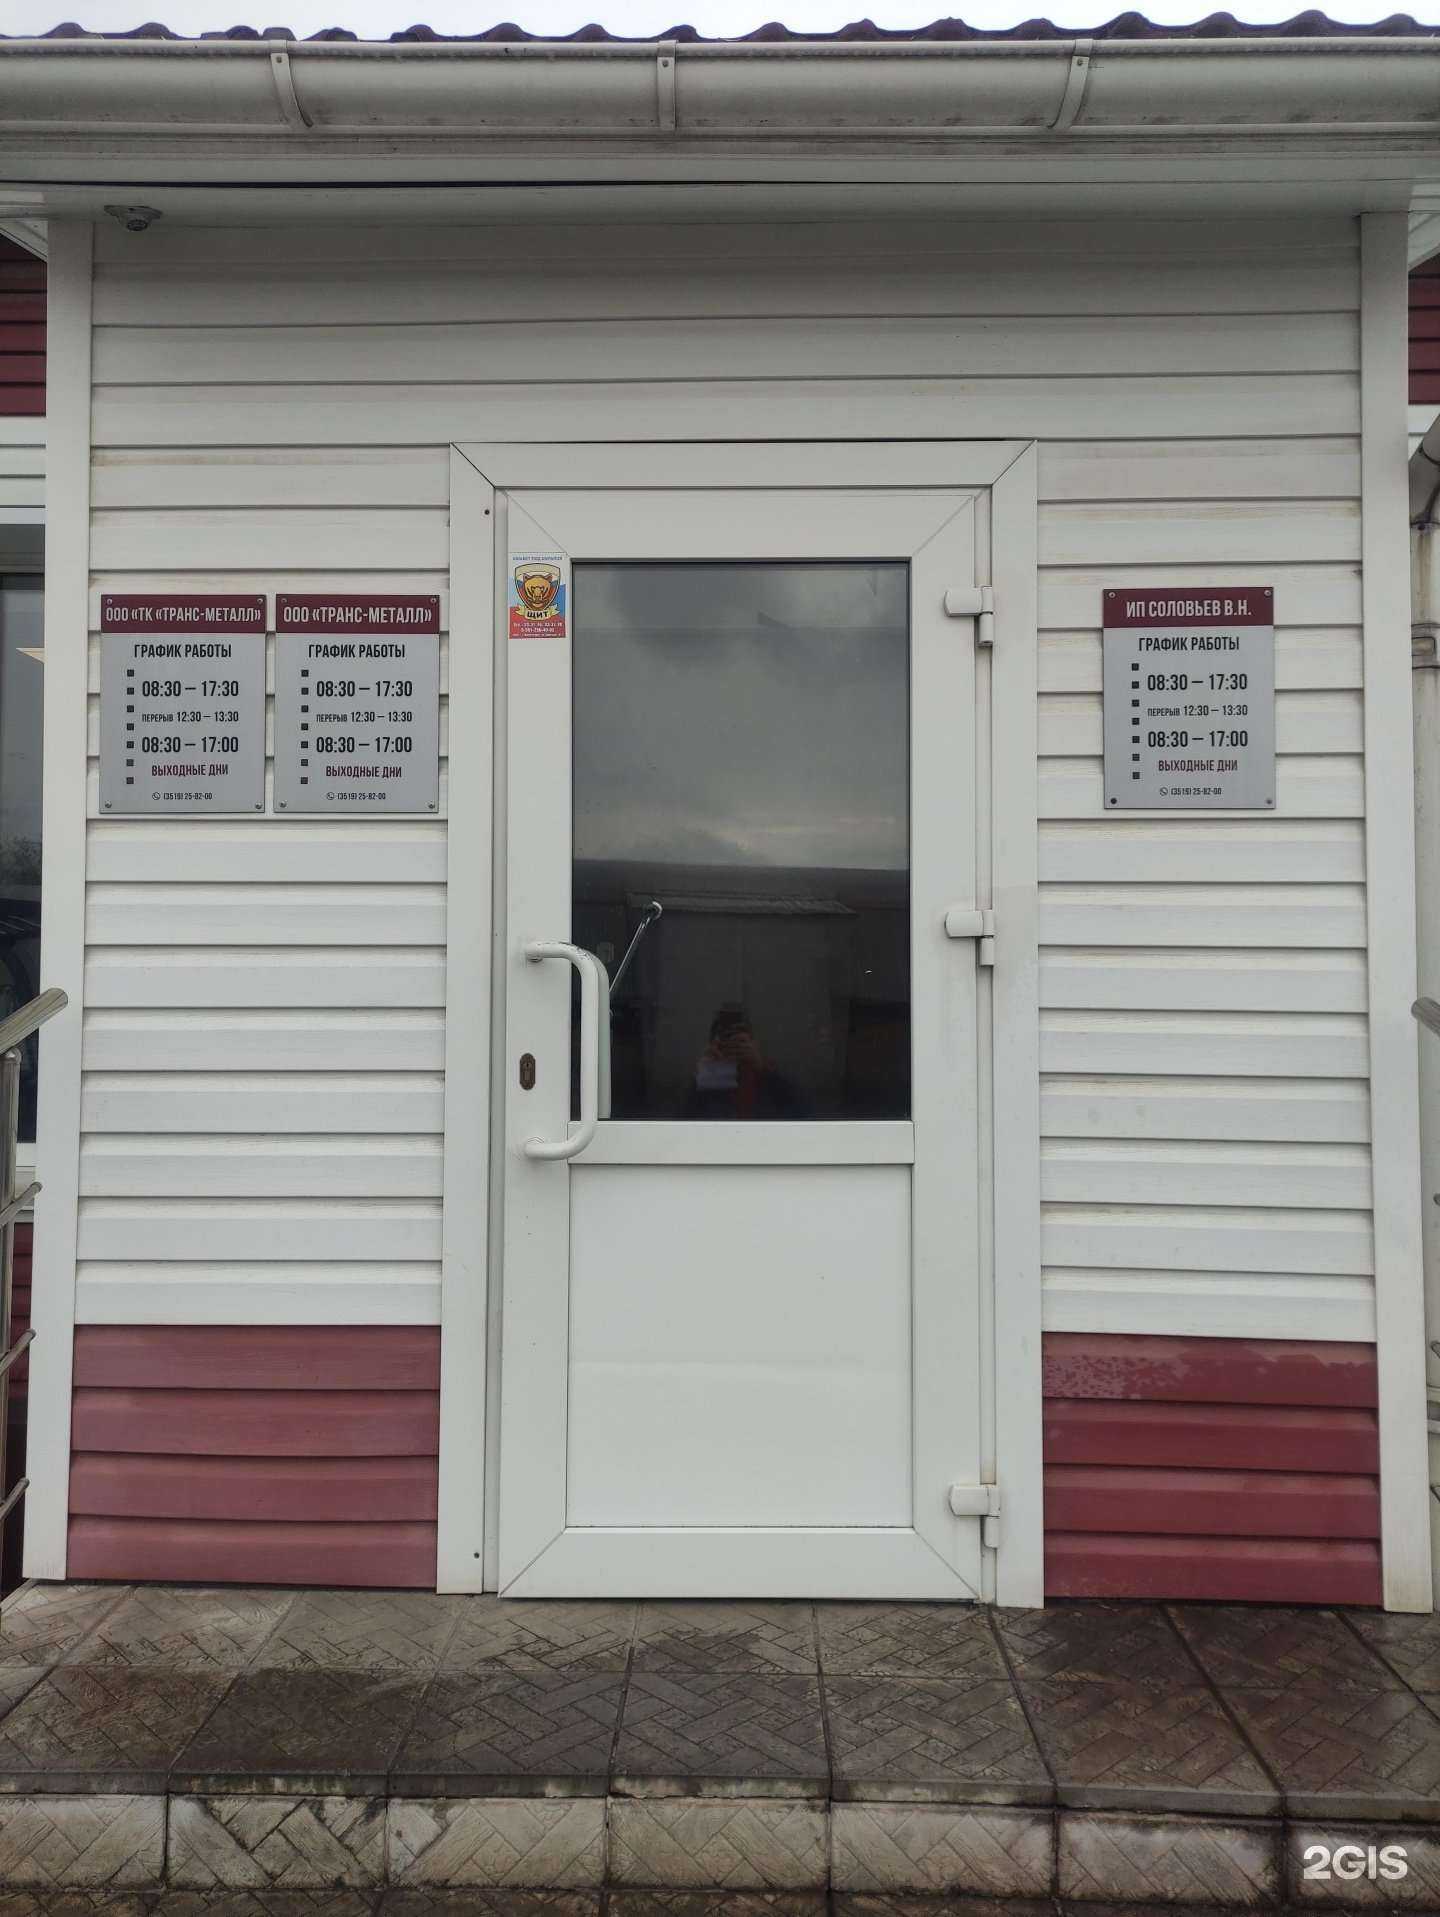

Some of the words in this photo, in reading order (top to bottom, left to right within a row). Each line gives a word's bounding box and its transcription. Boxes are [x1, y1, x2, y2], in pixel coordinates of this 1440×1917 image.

[106, 608, 128, 621] ООО
[132, 608, 152, 621] «ТК
[156, 608, 260, 622] «ТРАНС-МЕТАЛЛ»
[284, 607, 309, 622] ООО
[313, 607, 431, 623] «ТРАНС-МЕТАЛЛ»
[527, 611, 548, 619] ЩИТ
[1126, 602, 1145, 617] ИП
[1149, 600, 1220, 617] СОЛОВЬЕВ
[1225, 600, 1251, 615] В.Н.
[135, 644, 181, 657] ГРАФИК
[185, 644, 231, 657] РАБОТЫ
[1139, 638, 1187, 651] ГРАФИК
[1191, 637, 1239, 650] РАБОТЫ
[309, 645, 355, 658] ГРАФИК
[359, 645, 405, 658] РАБОТЫ
[142, 681, 181, 696] 08:30
[202, 681, 238, 696] 17:30
[317, 681, 355, 696] 08:30
[376, 681, 412, 696] 17:30
[1148, 675, 1187, 690] 08:30
[1209, 674, 1247, 690] 17:30
[142, 714, 173, 722] ПЕРЕРЫВ
[177, 712, 200, 722] 12:30
[215, 712, 238, 722] 13:30
[316, 714, 347, 722] ПЕРЕРЫВ
[351, 712, 375, 722] 12:30
[389, 712, 412, 722] 13:30
[1148, 708, 1180, 716] ПЕРЕРЫВ
[1184, 705, 1209, 715] 12:30
[1223, 705, 1248, 715] 13:30
[142, 737, 181, 752] 08:30
[202, 737, 238, 752] 17:00
[316, 737, 355, 752] 08:30
[375, 737, 412, 752] 17:00
[1148, 731, 1188, 747] 08:30
[1209, 731, 1248, 746] 17:00
[152, 765, 206, 777] ВЫХОДНЫЕ
[209, 764, 228, 776] ДНИ
[326, 766, 379, 778] ВЫХОДНЫЕ
[383, 767, 401, 778] ДНИ
[1159, 760, 1214, 772] ВЫХОДНЫЕ
[1217, 760, 1237, 772] ДНИ
